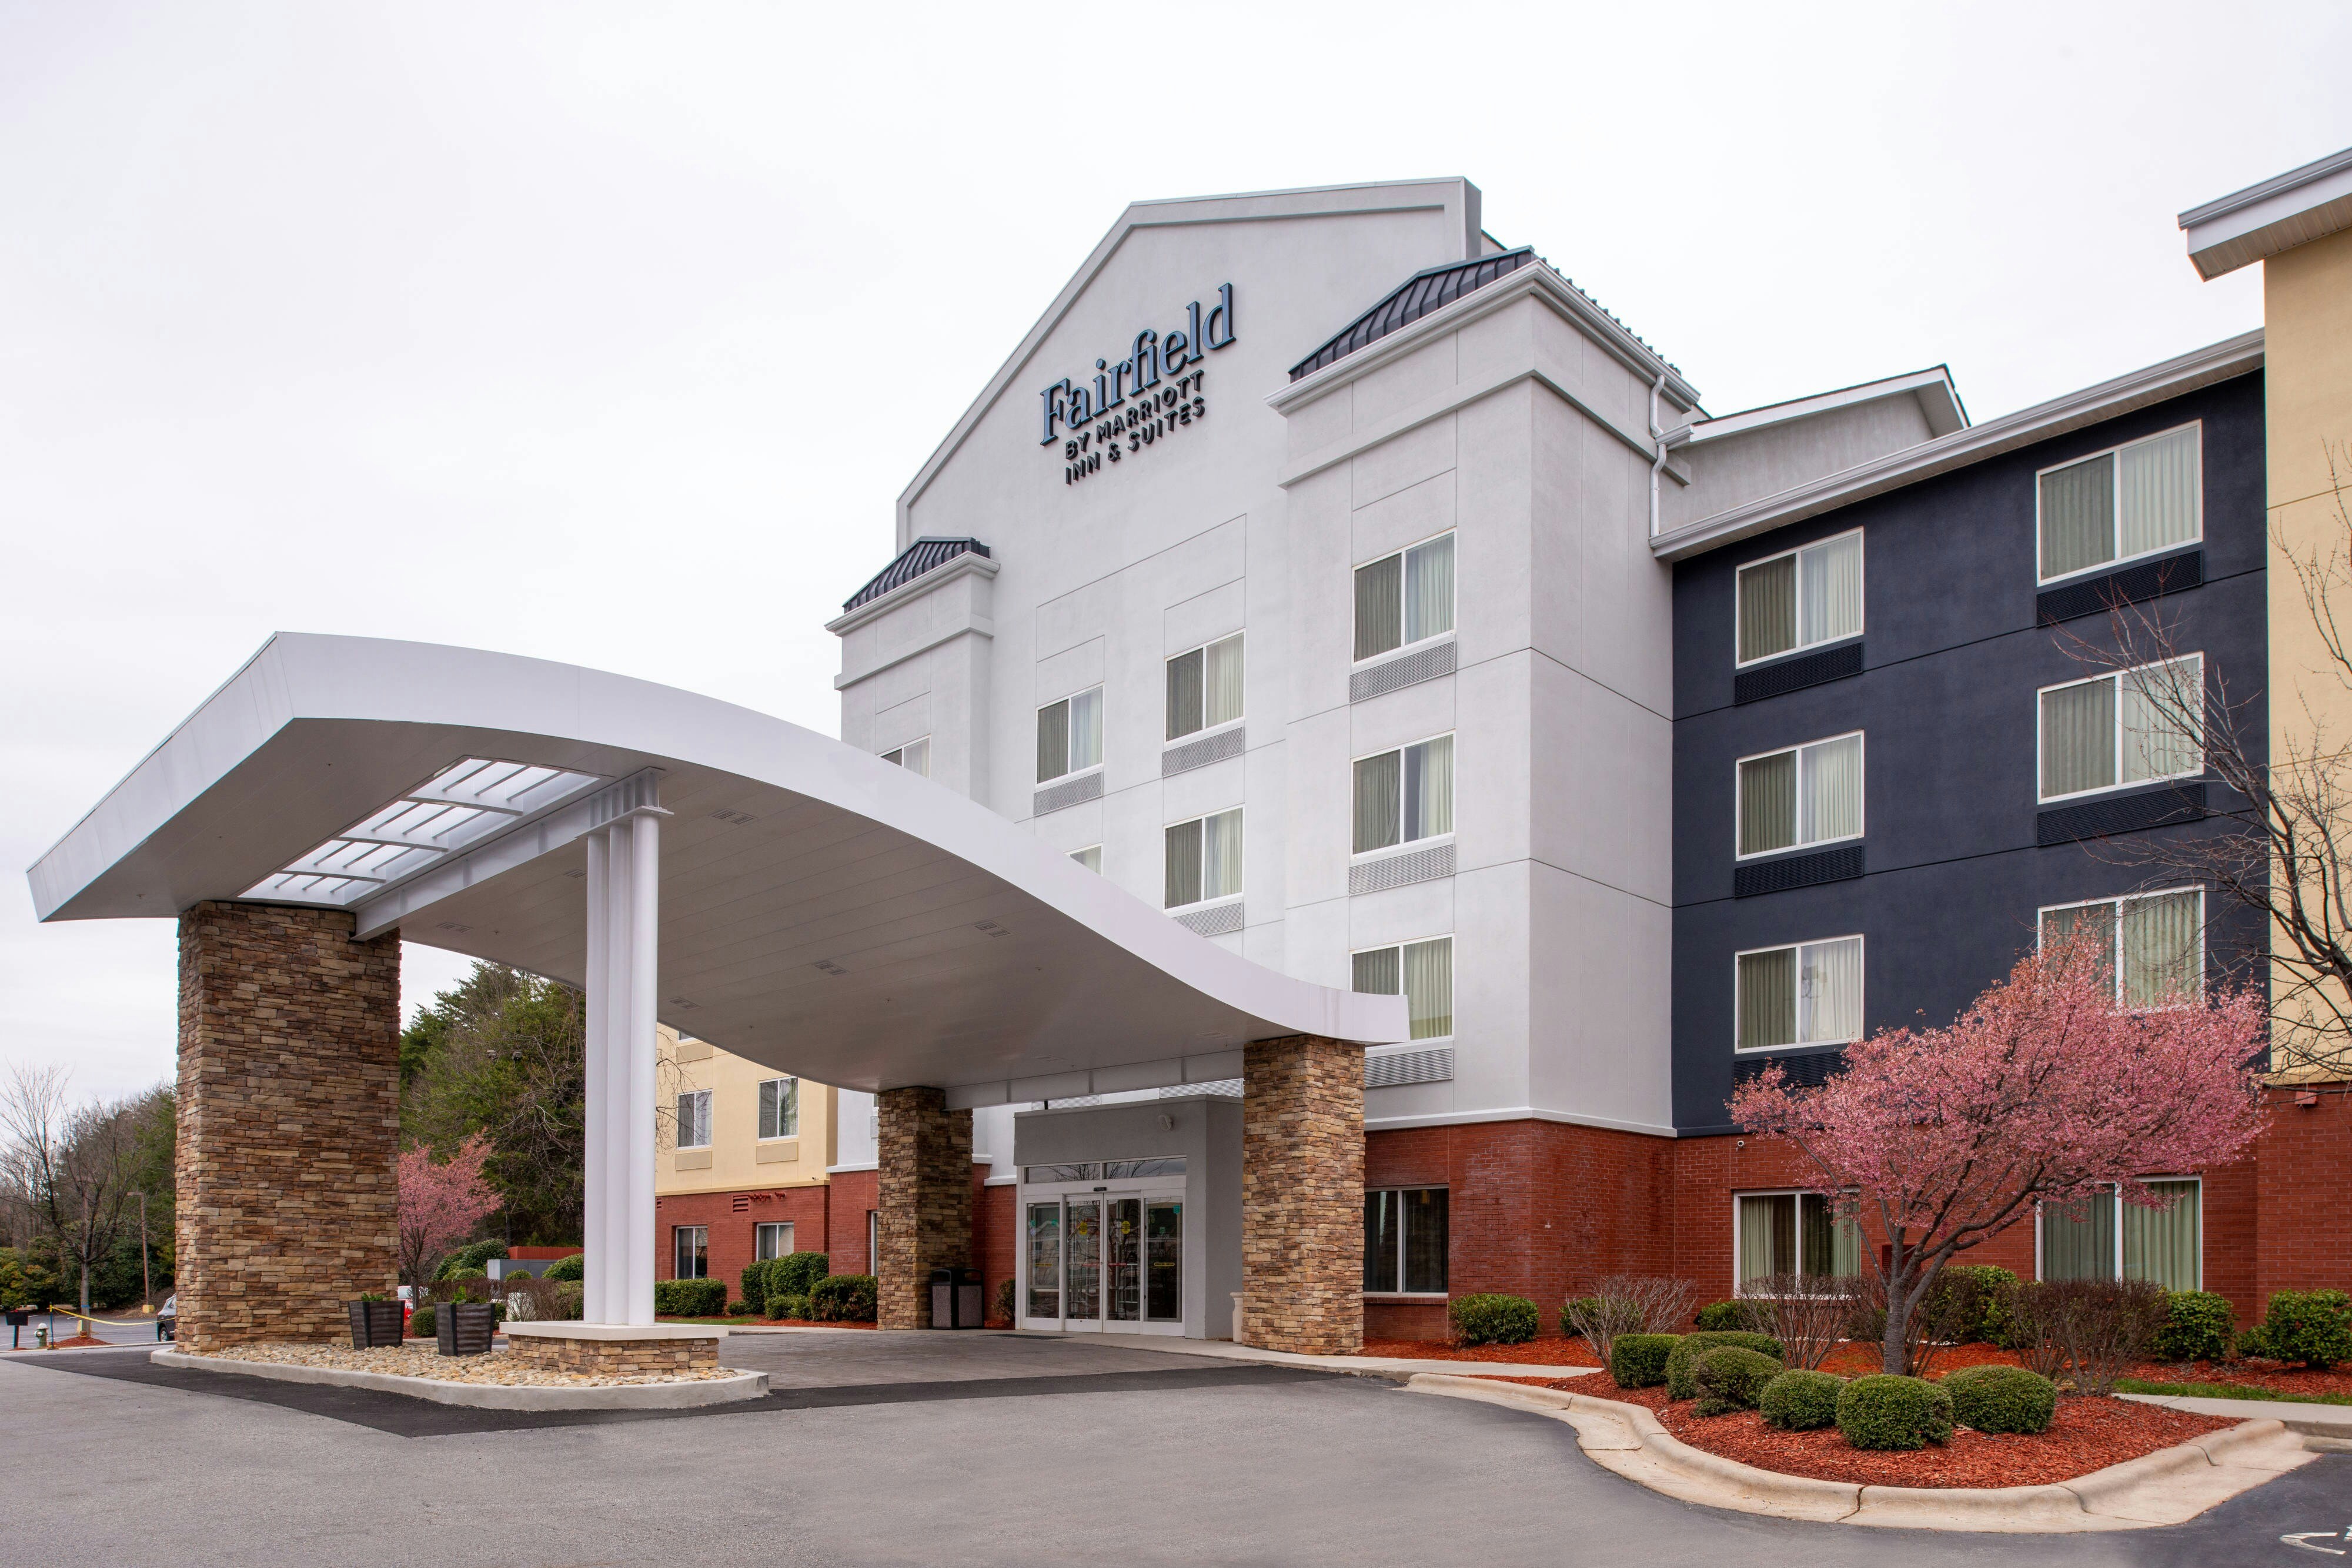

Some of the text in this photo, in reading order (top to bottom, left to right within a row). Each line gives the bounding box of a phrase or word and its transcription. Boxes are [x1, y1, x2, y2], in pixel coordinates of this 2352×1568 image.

[1040, 283, 1236, 446] Fairfield
[1065, 370, 1204, 460] BY MARRIOTT
[1065, 396, 1205, 485] INN & SUITES
